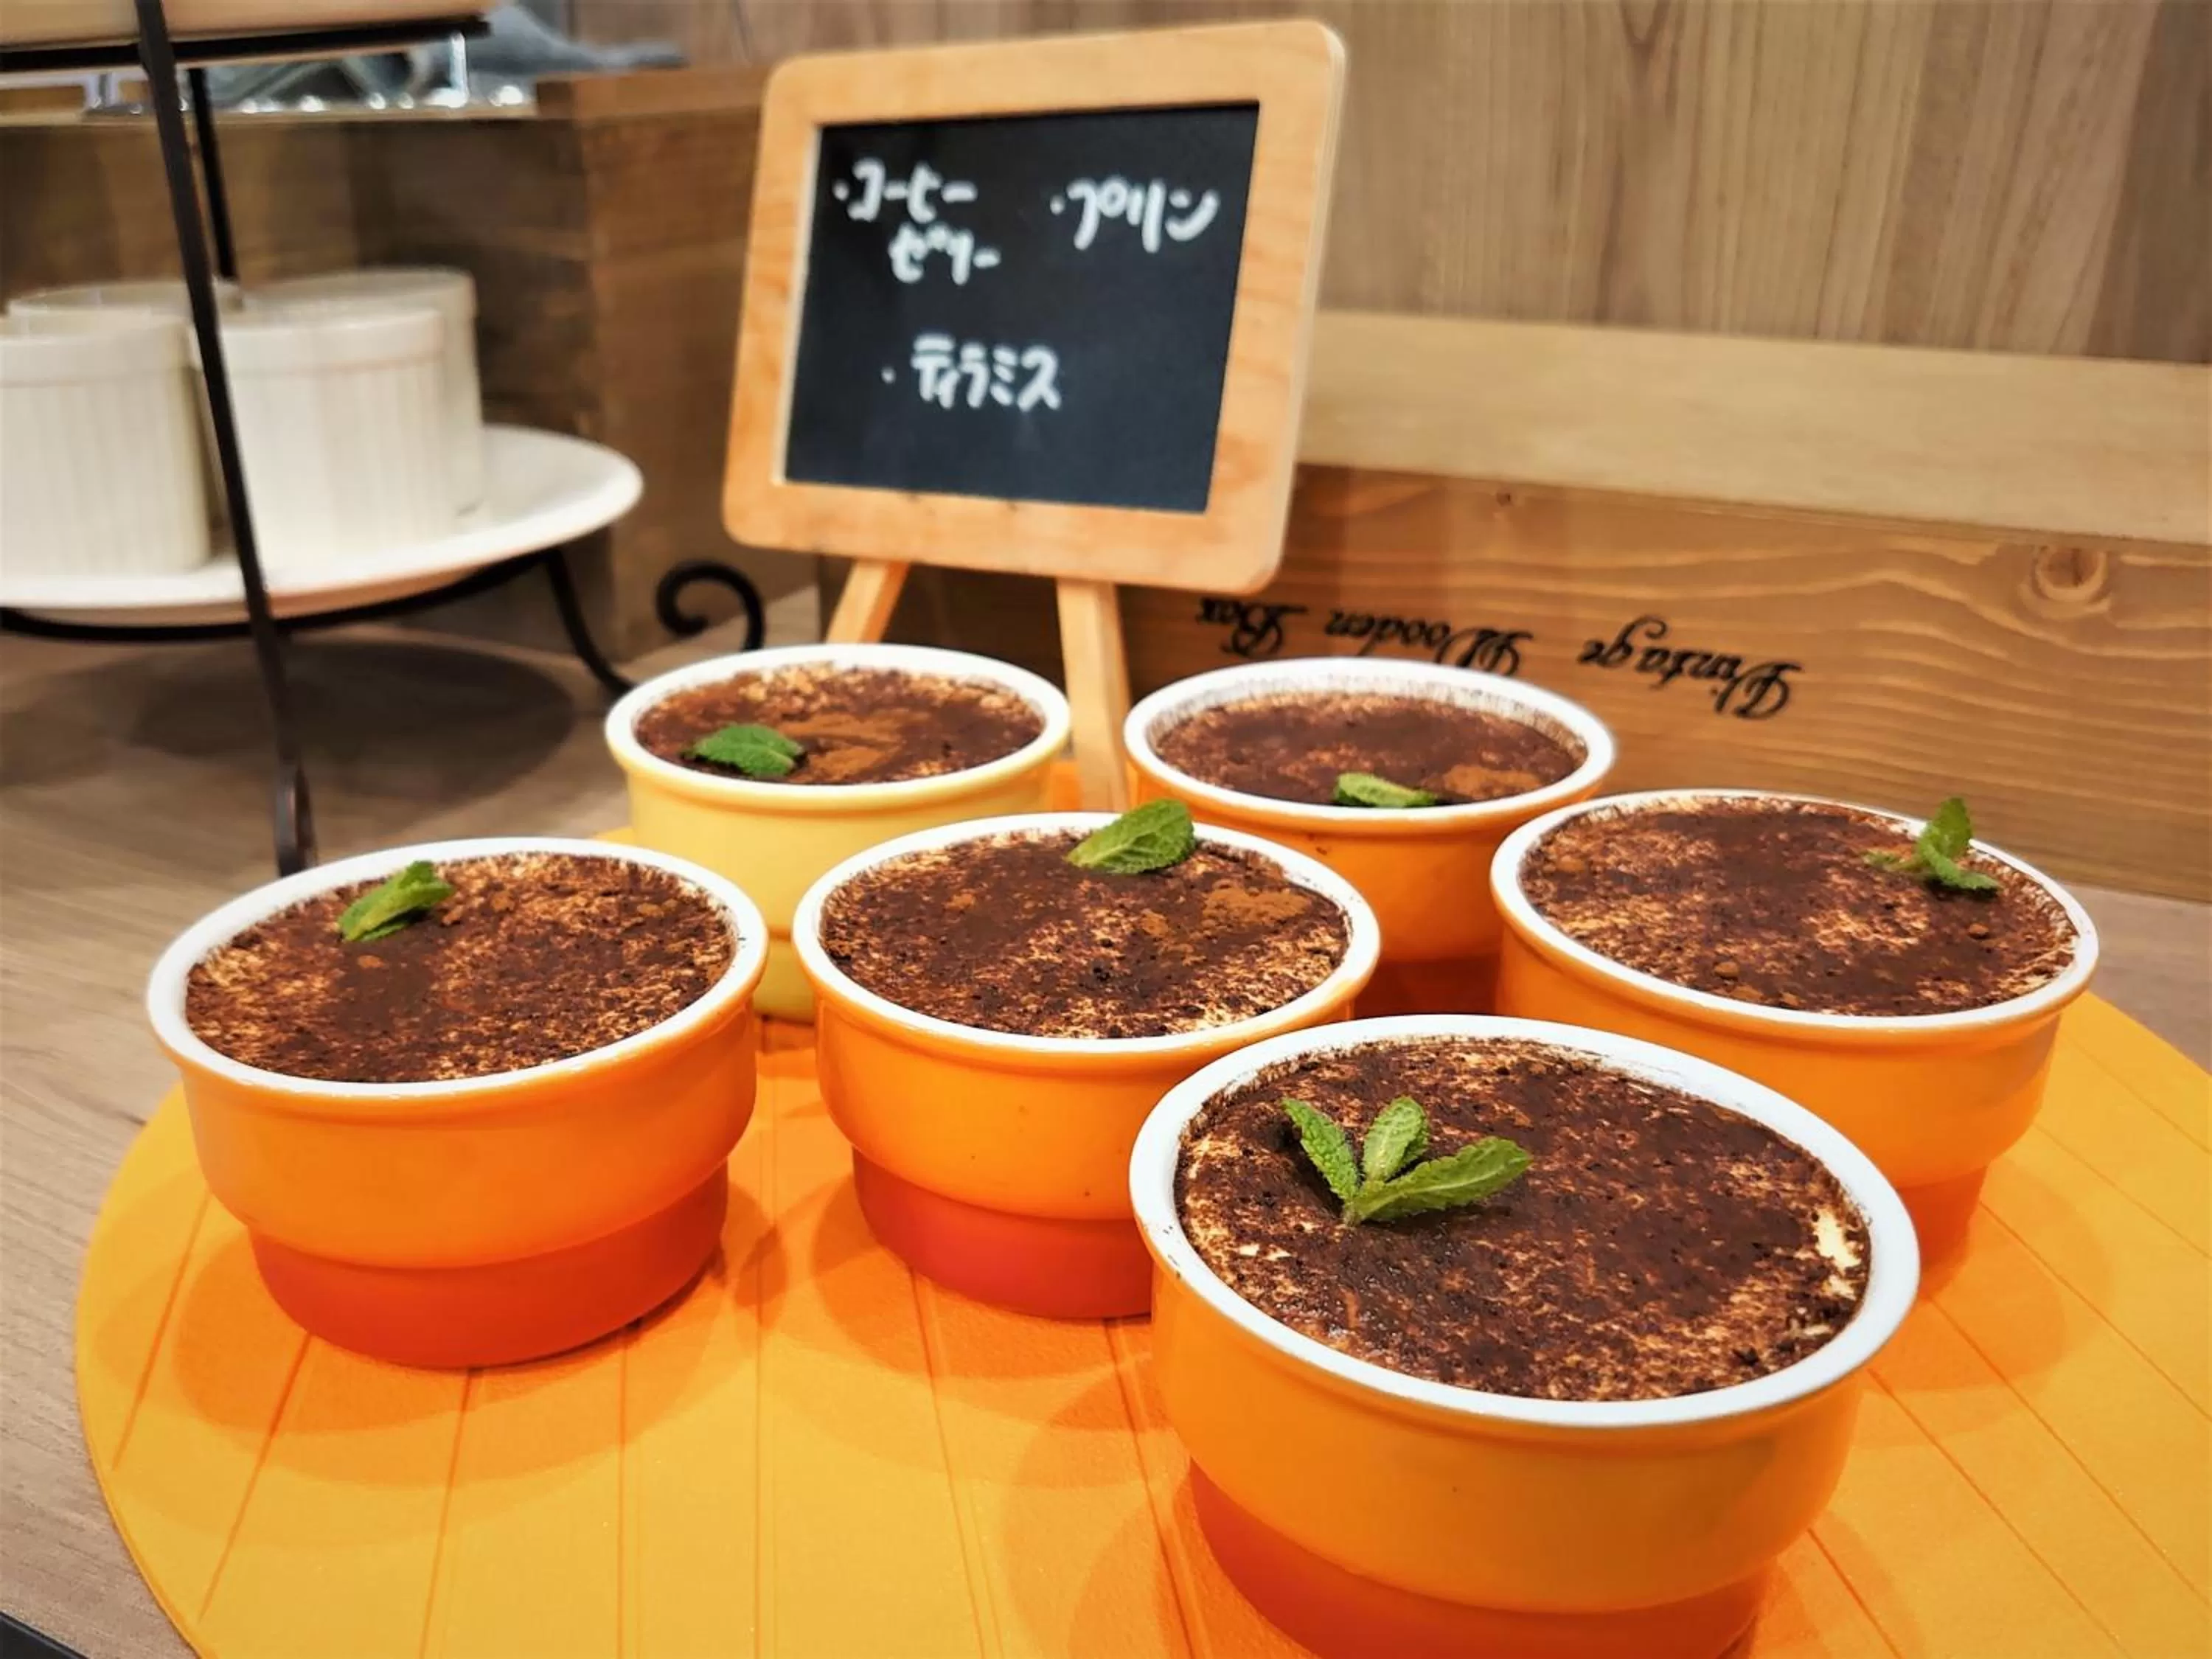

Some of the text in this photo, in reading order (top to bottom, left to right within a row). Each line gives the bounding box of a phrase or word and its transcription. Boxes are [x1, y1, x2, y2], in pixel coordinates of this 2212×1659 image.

[888, 222, 1001, 285] ゼリー
[1197, 596, 1804, 720] Vintage Wooden Box
